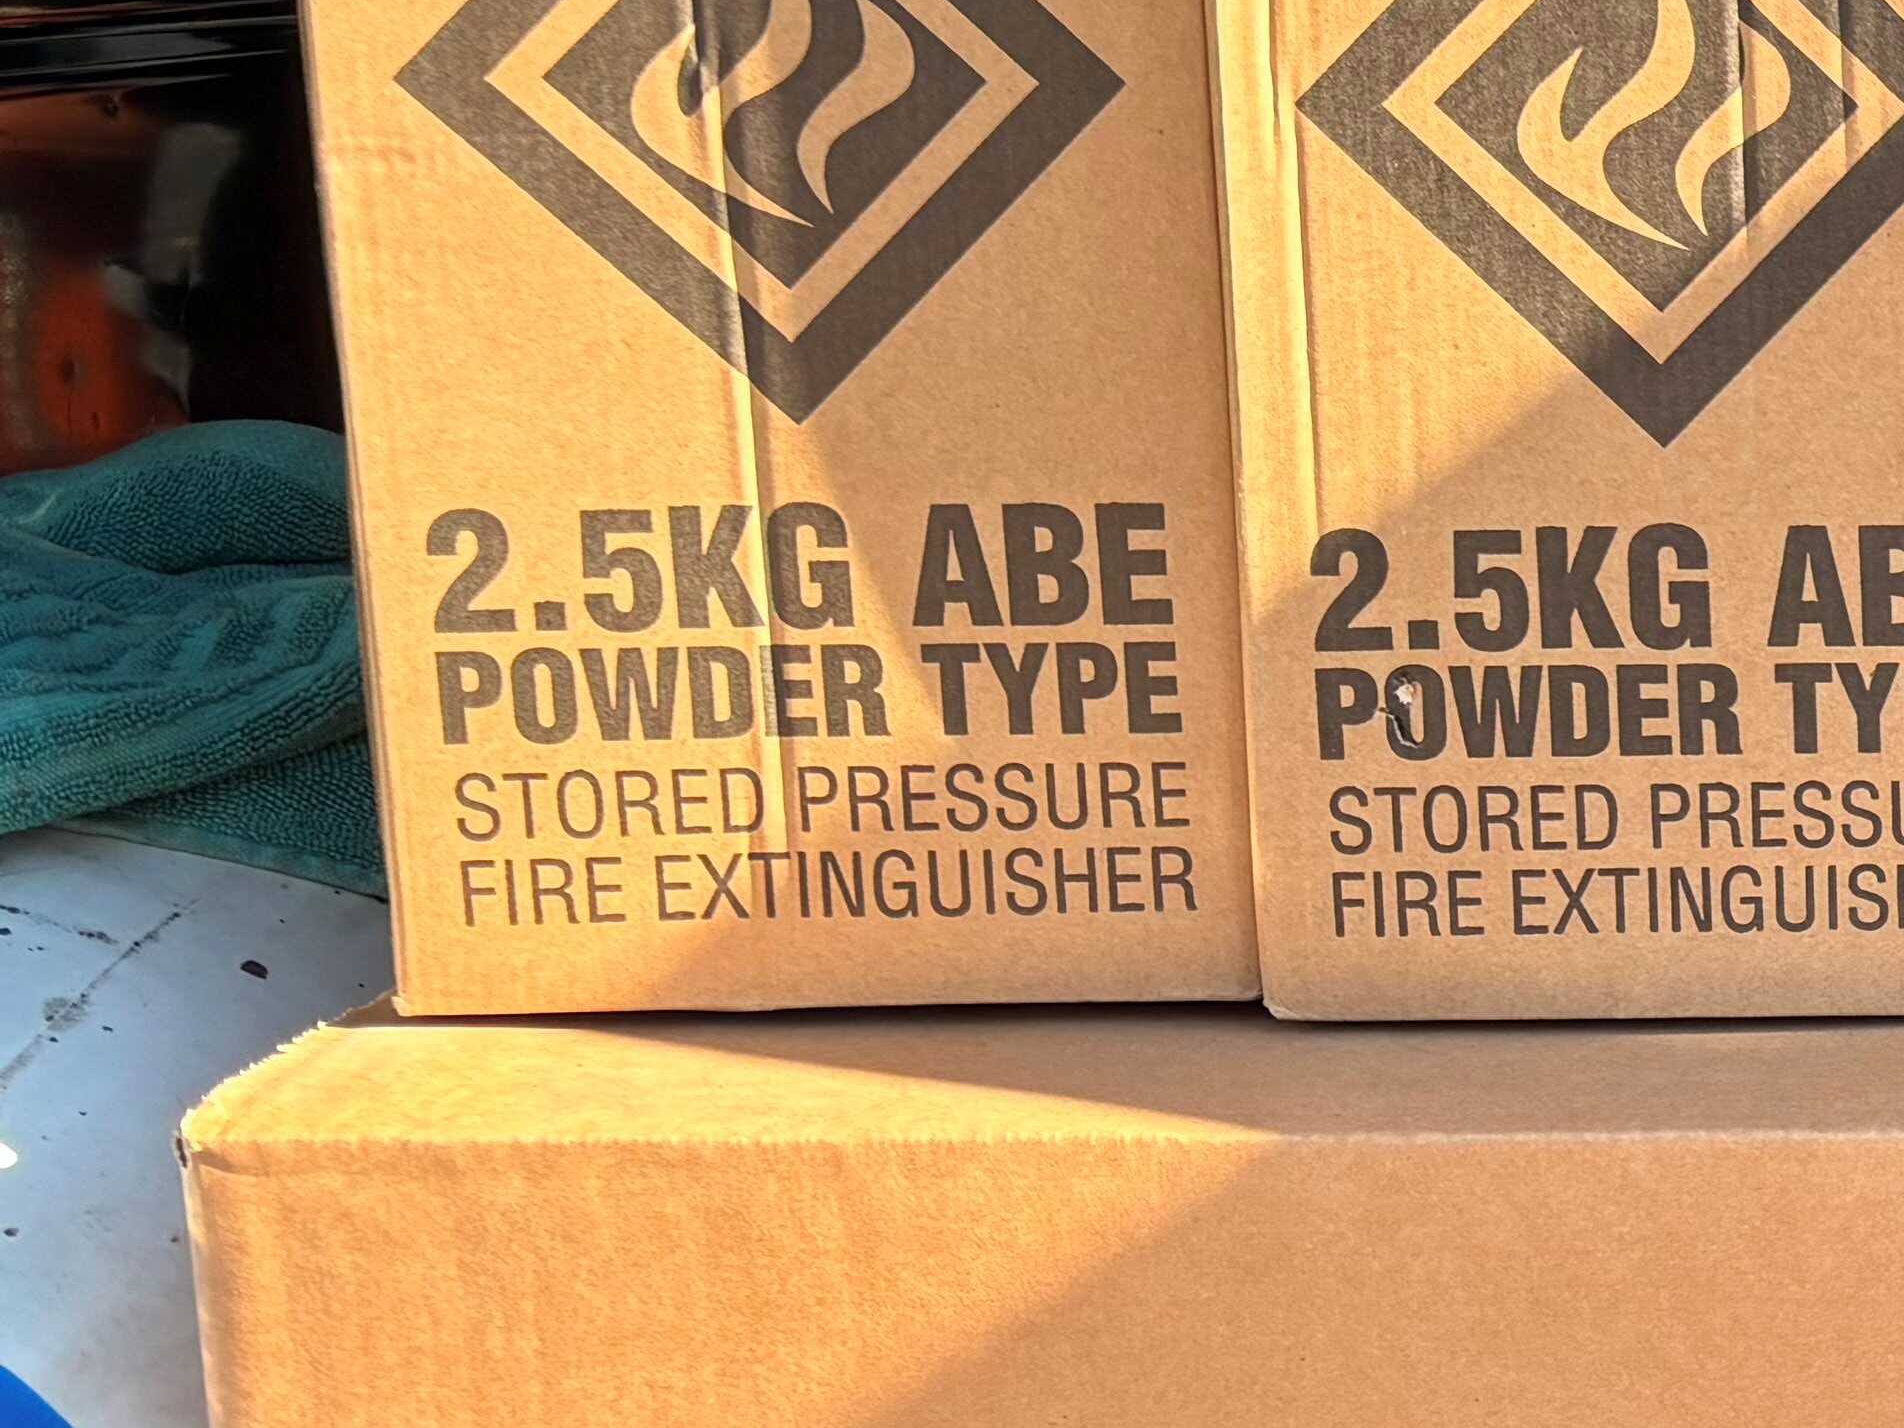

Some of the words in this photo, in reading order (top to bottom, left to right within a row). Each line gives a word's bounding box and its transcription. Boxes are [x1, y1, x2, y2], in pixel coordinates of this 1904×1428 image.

[426, 501, 855, 633] 2.5KG
[913, 502, 1175, 628] ABE
[1311, 523, 1712, 652] 2.5KG
[435, 643, 891, 744] POWDER
[921, 641, 1182, 734] TYPE
[1314, 663, 1743, 761] POWDER
[454, 767, 764, 840] STORED
[799, 762, 1191, 832] PRESSURE
[1329, 783, 1618, 855] STORED
[461, 855, 626, 926] FIRE
[656, 846, 1198, 923] EXTINGUISHER
[1331, 869, 1485, 938] FIRE
